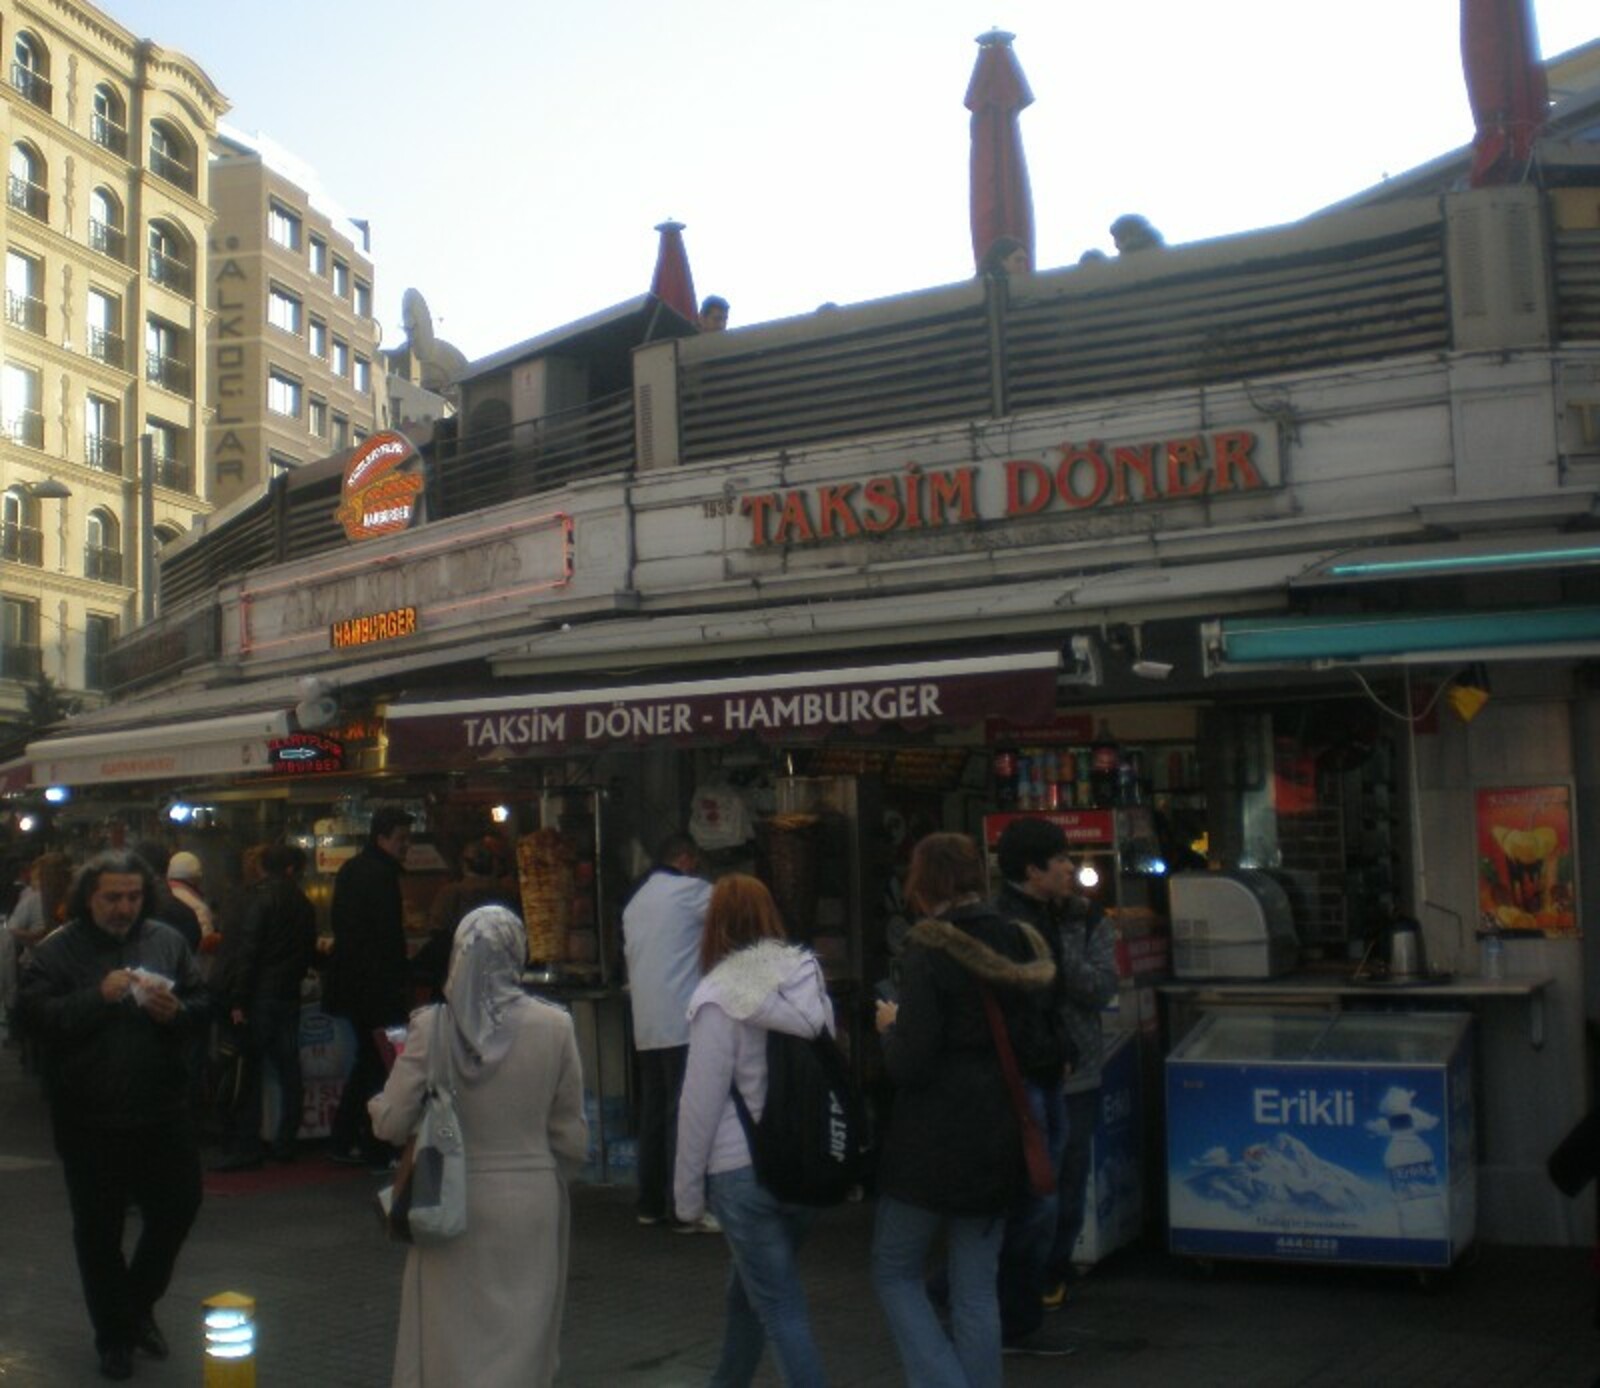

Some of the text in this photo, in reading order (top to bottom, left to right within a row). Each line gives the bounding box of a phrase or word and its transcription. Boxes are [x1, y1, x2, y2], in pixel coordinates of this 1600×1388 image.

[741, 429, 1264, 545] TAKSİM DÖNER
[363, 505, 410, 527] HAMBURGER
[331, 608, 418, 647] HAMBURGER
[463, 708, 565, 747] TAKSİM
[585, 702, 693, 740] DÖNER
[725, 683, 943, 730] HAMBURGER
[1252, 1087, 1356, 1126] Erikli
[829, 1118, 848, 1162] JUST
